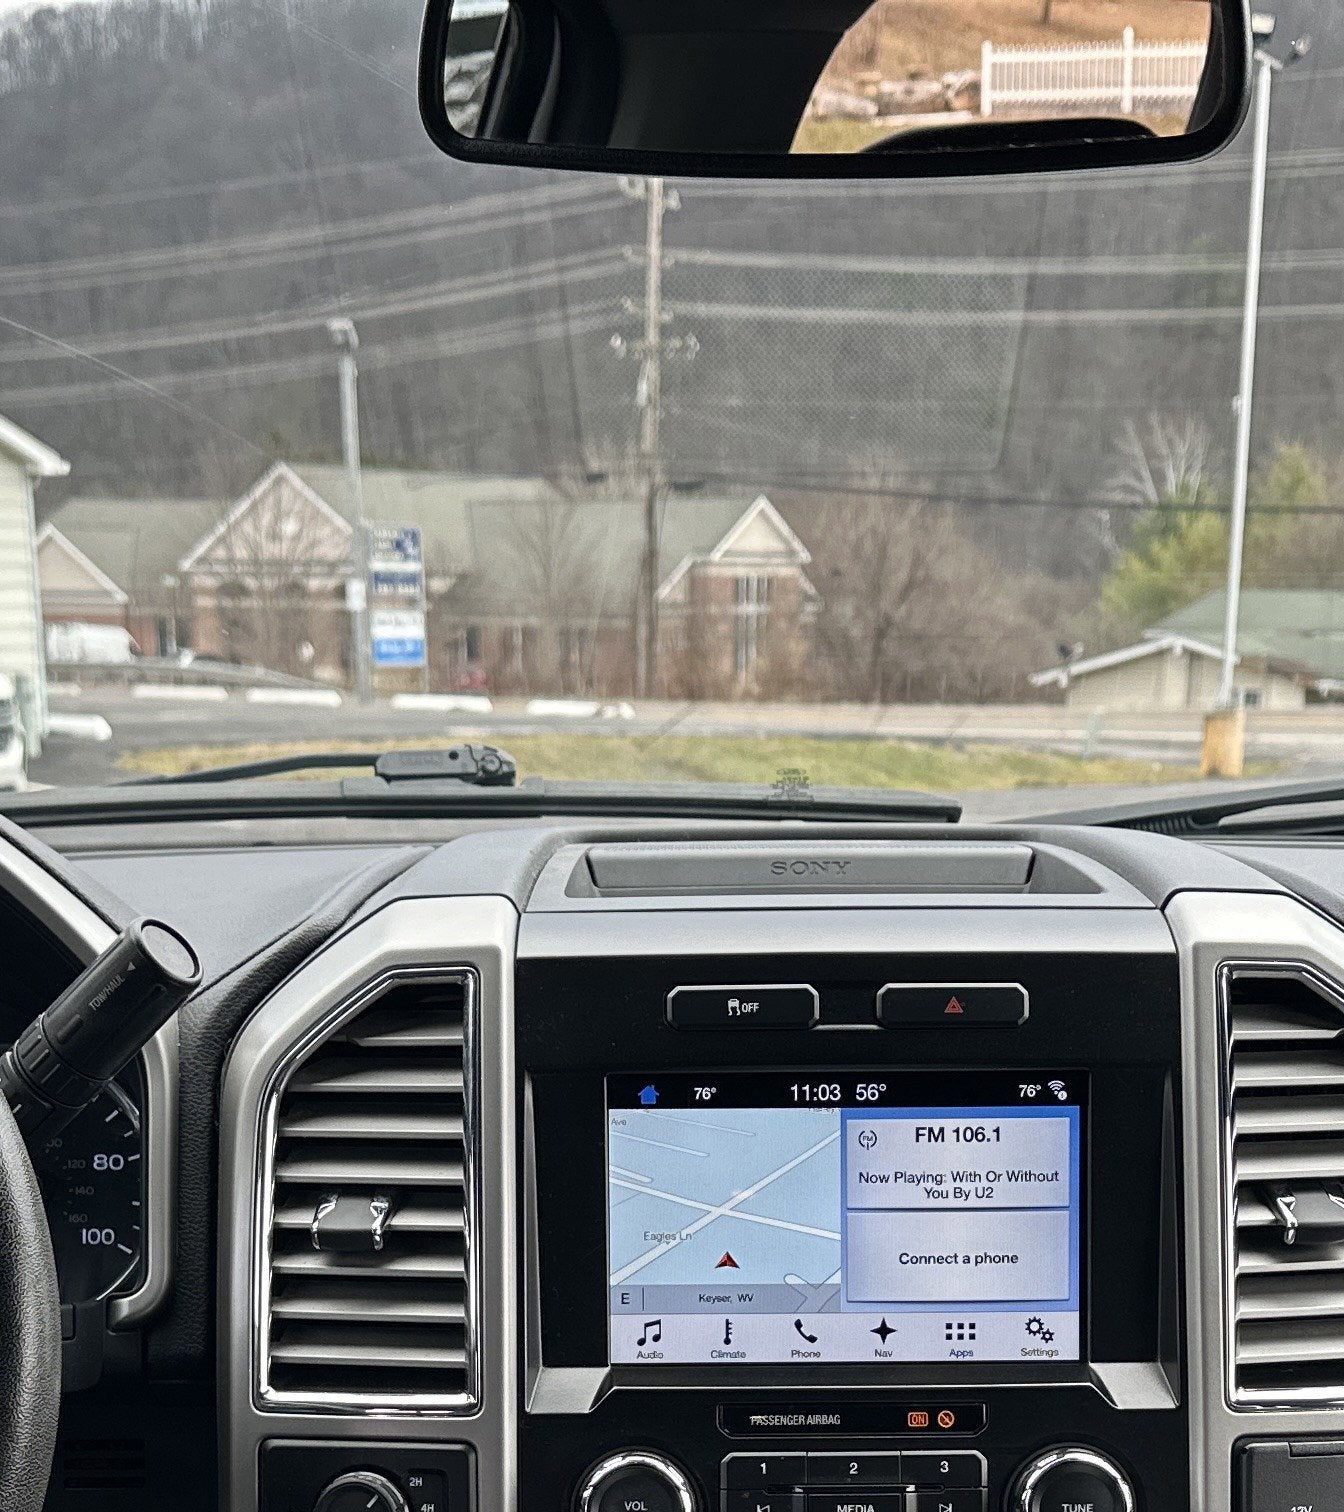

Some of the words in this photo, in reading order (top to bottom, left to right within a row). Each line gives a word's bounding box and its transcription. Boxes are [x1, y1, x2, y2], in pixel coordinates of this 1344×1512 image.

[770, 861, 851, 875] SONY
[741, 1002, 760, 1013] OFF
[694, 1087, 717, 1100] 76°
[790, 1083, 841, 1101] 11:03
[855, 1083, 887, 1100] 56°
[1018, 1084, 1041, 1098] 76°
[915, 1126, 945, 1143] FM
[952, 1126, 1001, 1143] 106.1
[92, 1153, 125, 1171] 80
[858, 1172, 890, 1184] Now
[894, 1171, 947, 1186] Playing:
[951, 1170, 982, 1183] With
[985, 1170, 1003, 1183] Or
[1006, 1169, 1060, 1183] Without
[924, 1187, 949, 1199] You
[953, 1187, 971, 1201] By
[975, 1186, 994, 1199] U2
[81, 1227, 116, 1245] 100
[643, 1231, 676, 1243] Eagles
[679, 1231, 692, 1241] Ln
[898, 1252, 959, 1265] Connect
[962, 1255, 971, 1265] a
[974, 1252, 1019, 1267] phone
[620, 1293, 630, 1305] E
[737, 1293, 754, 1303] WV
[636, 1350, 664, 1360] Audio
[710, 1350, 747, 1359] Climate
[790, 1350, 821, 1359] Phone
[874, 1349, 893, 1358] Nav
[948, 1348, 974, 1359] Apps
[1020, 1347, 1059, 1358] Settings
[750, 1415, 806, 1426] PASSENGER
[806, 1414, 841, 1425] AIRBAG
[911, 1415, 925, 1425] ON
[760, 1462, 767, 1475] 1
[849, 1462, 859, 1474] 2
[939, 1460, 949, 1473] 3
[408, 1476, 423, 1488] 2H
[624, 1501, 648, 1512] VOL
